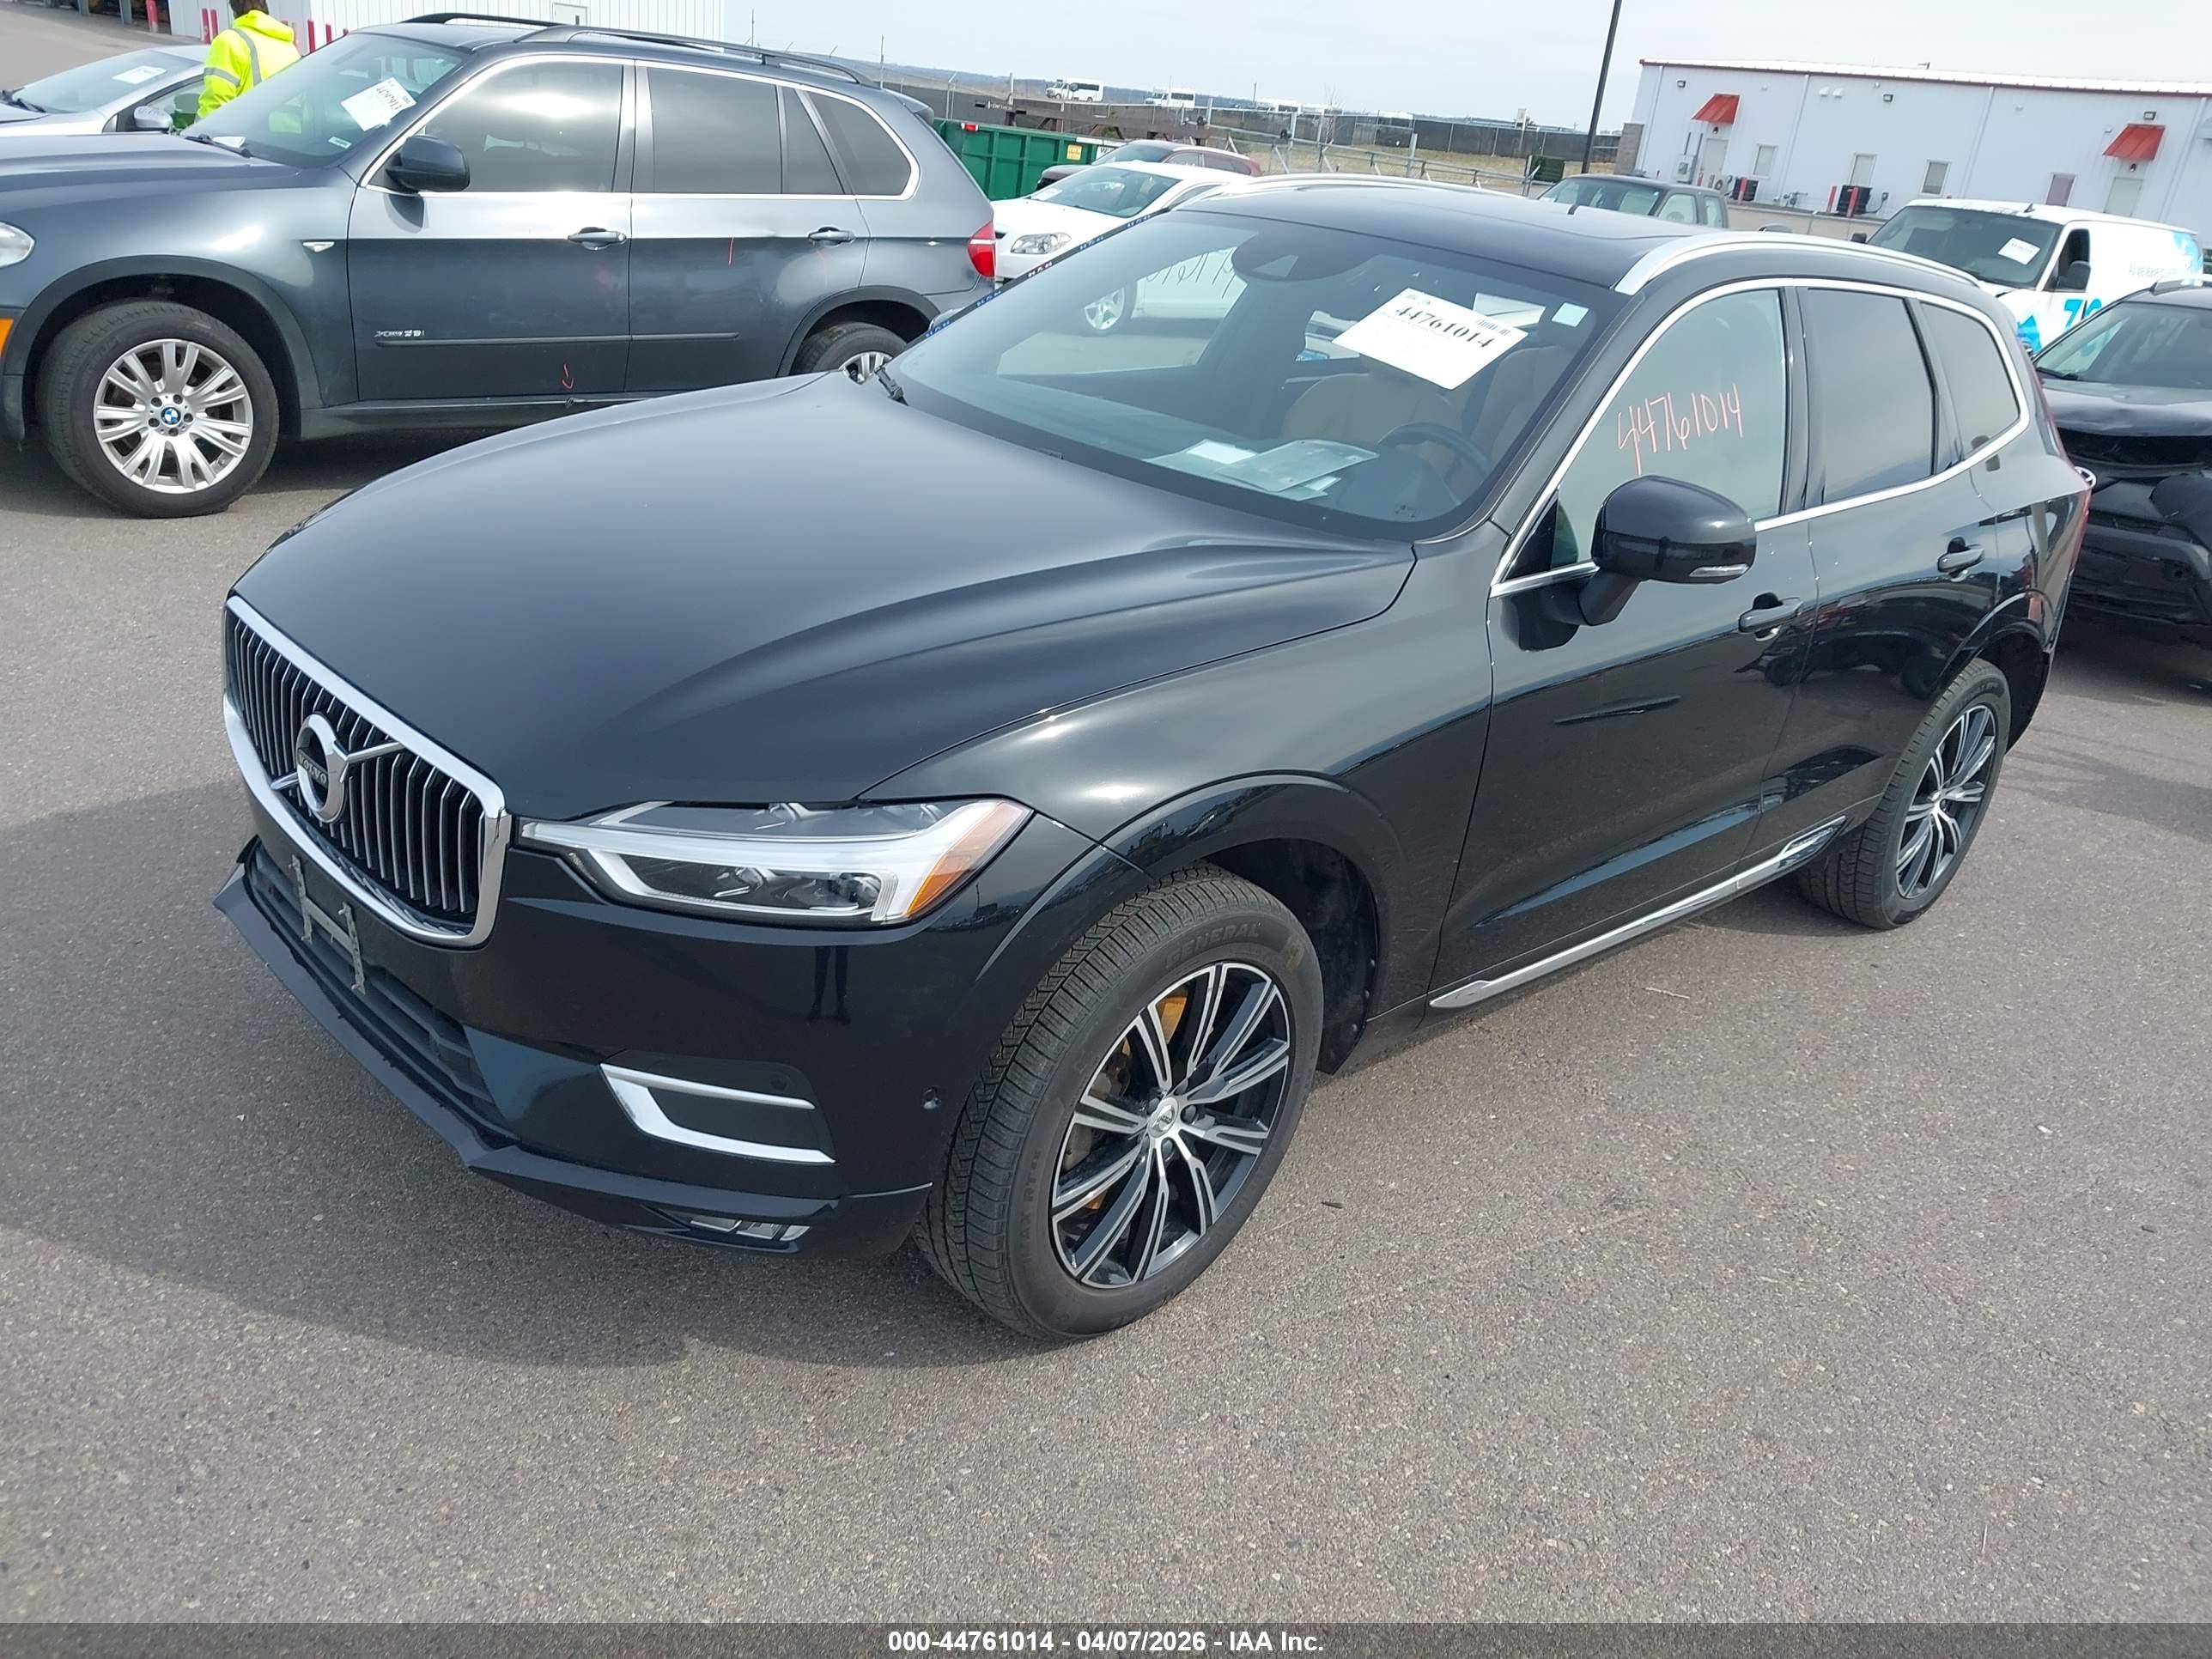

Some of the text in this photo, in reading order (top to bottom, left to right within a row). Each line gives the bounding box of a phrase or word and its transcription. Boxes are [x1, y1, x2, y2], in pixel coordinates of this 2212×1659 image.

[1395, 306, 1496, 349] 44761014
[1618, 382, 1744, 476] 44761014
[298, 752, 327, 784] VOLVO
[1166, 922, 1260, 967] GENERAL
